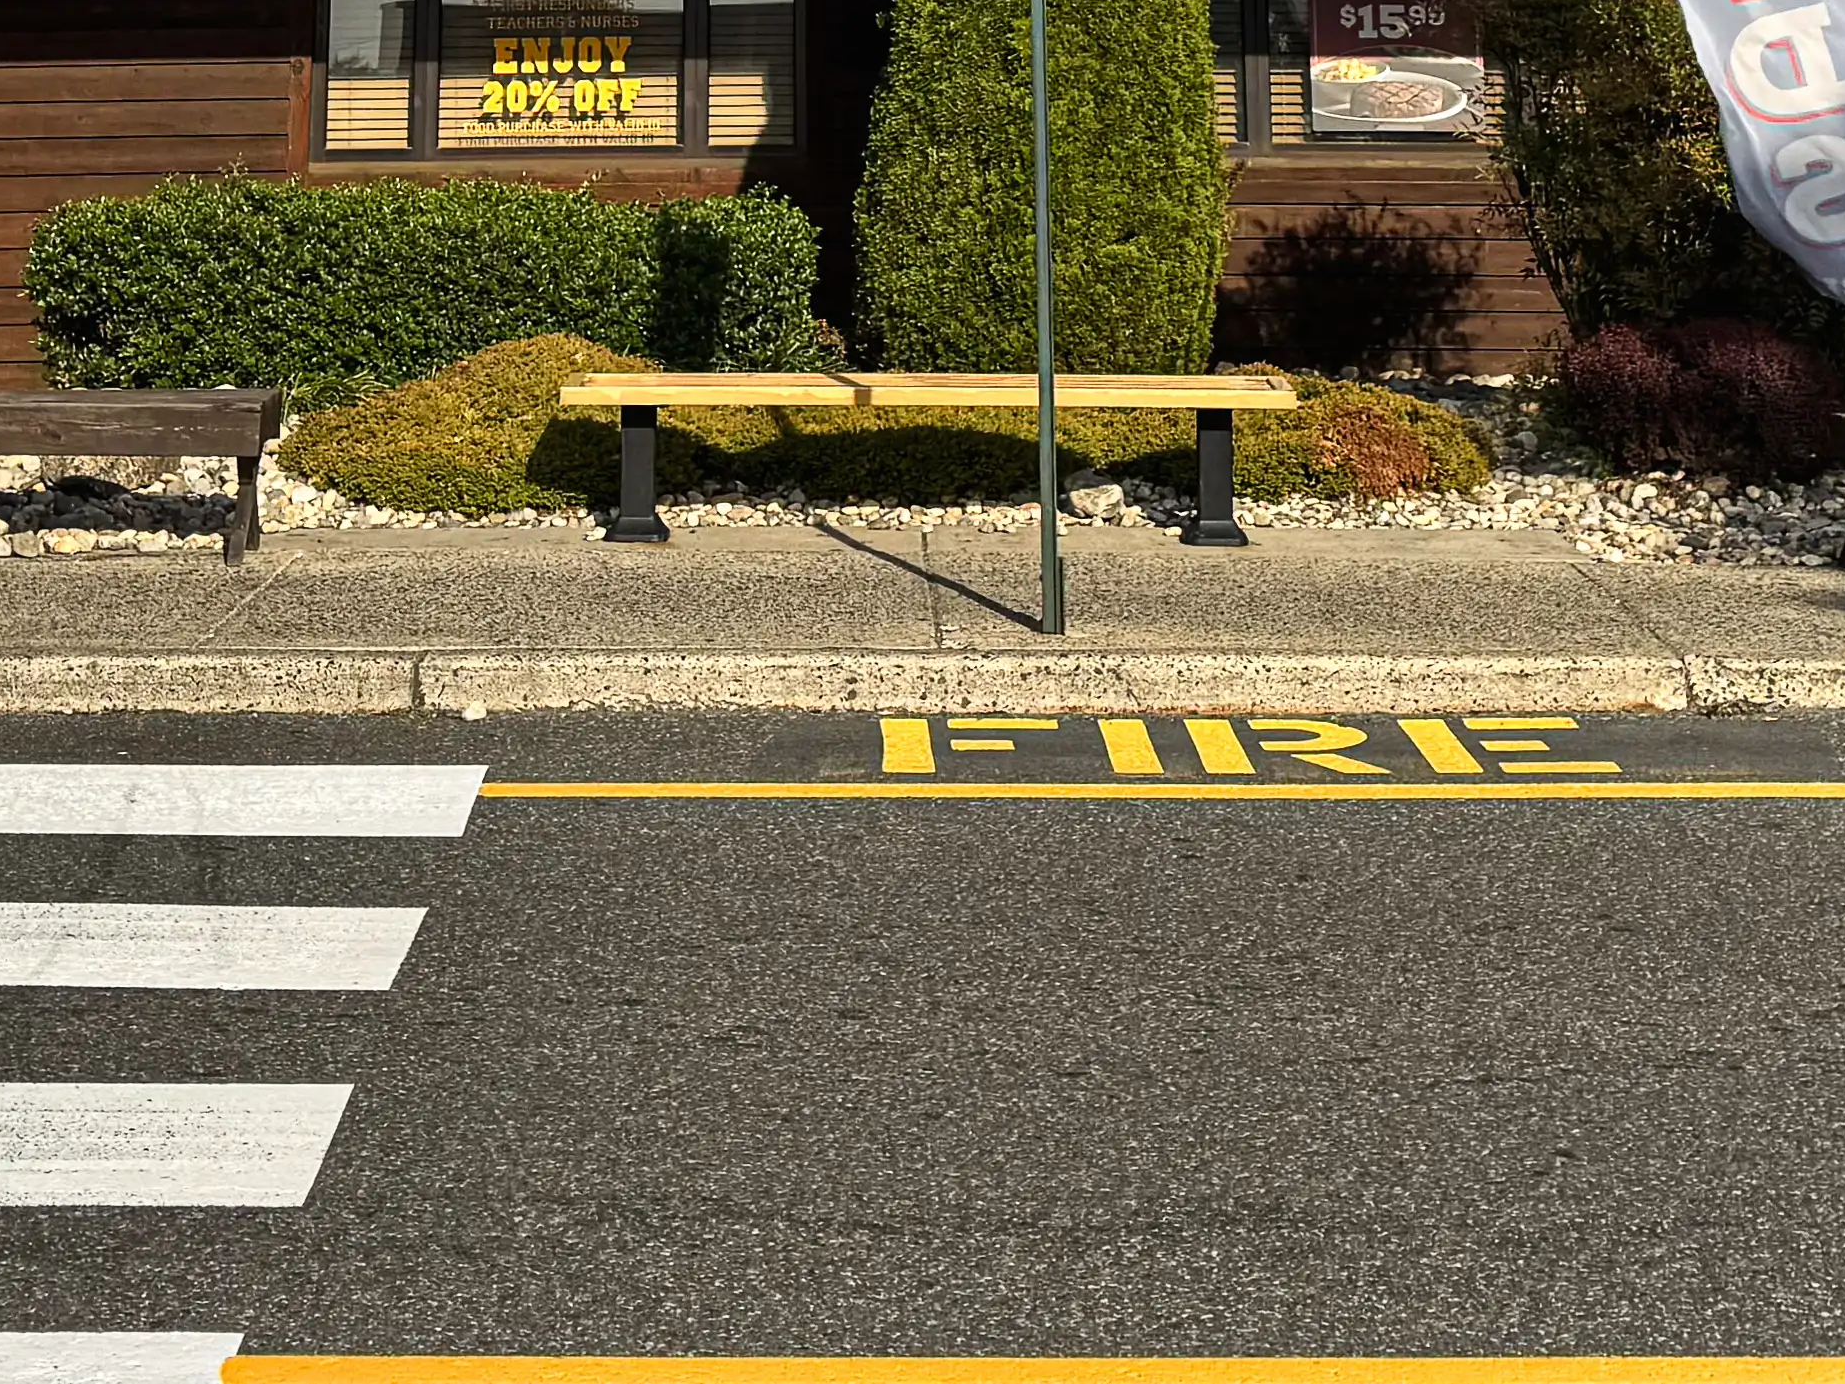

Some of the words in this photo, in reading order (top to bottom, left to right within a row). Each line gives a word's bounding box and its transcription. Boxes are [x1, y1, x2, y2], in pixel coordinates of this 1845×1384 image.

[487, 17, 564, 29] TEACHERS
[581, 15, 639, 28] NURSES
[493, 36, 632, 75] ENJOY
[482, 80, 561, 115] 20%
[574, 79, 642, 113] OFF
[879, 717, 1622, 775] FIRE
